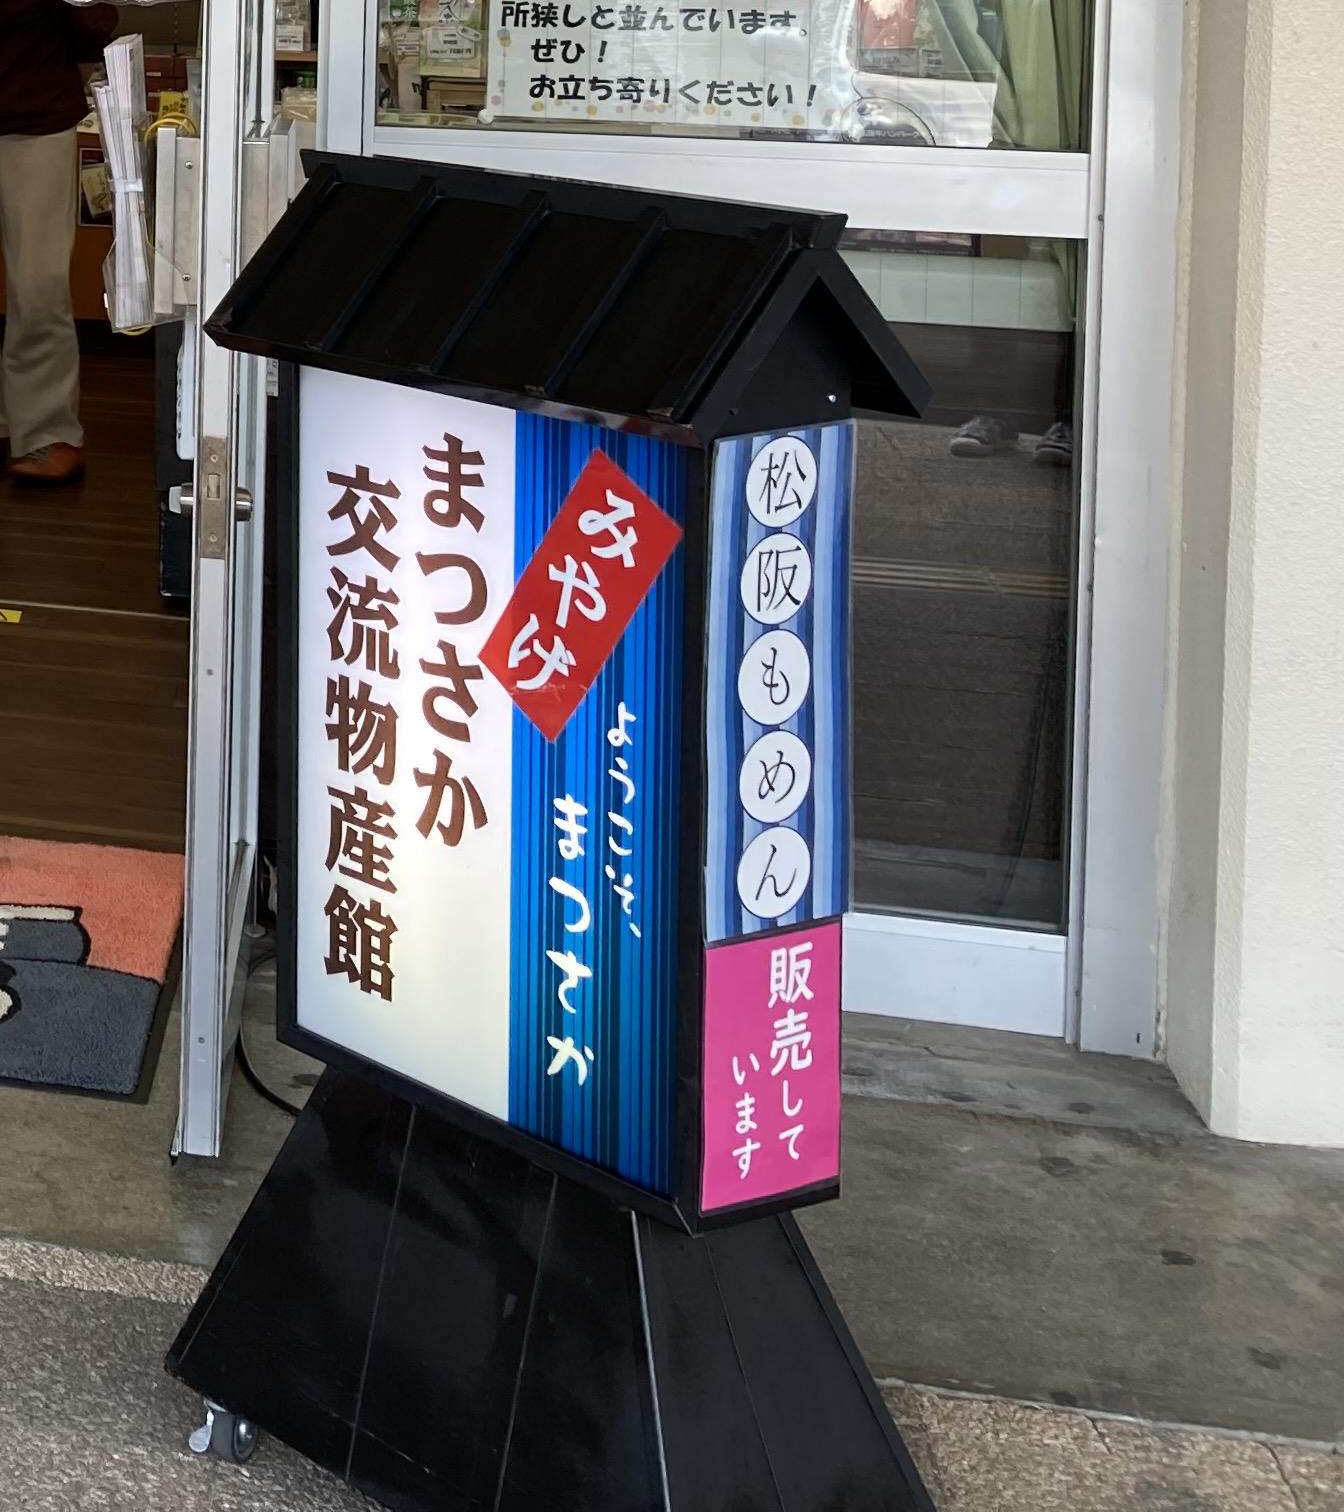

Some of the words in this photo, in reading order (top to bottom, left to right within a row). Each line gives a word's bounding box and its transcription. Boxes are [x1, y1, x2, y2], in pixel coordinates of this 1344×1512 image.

[500, 0, 809, 38] 所狭しと並んでいます。
[528, 73, 818, 110] お立ち寄りください！
[530, 38, 611, 65] ぜひ！
[413, 432, 489, 849] まつさか
[506, 488, 640, 693] みやげ
[748, 449, 808, 904] 松阪もめん
[323, 464, 402, 1004] 交流物産館
[545, 792, 597, 1088] まつさか
[730, 1053, 762, 1181] います
[767, 940, 816, 1164] 販売して
